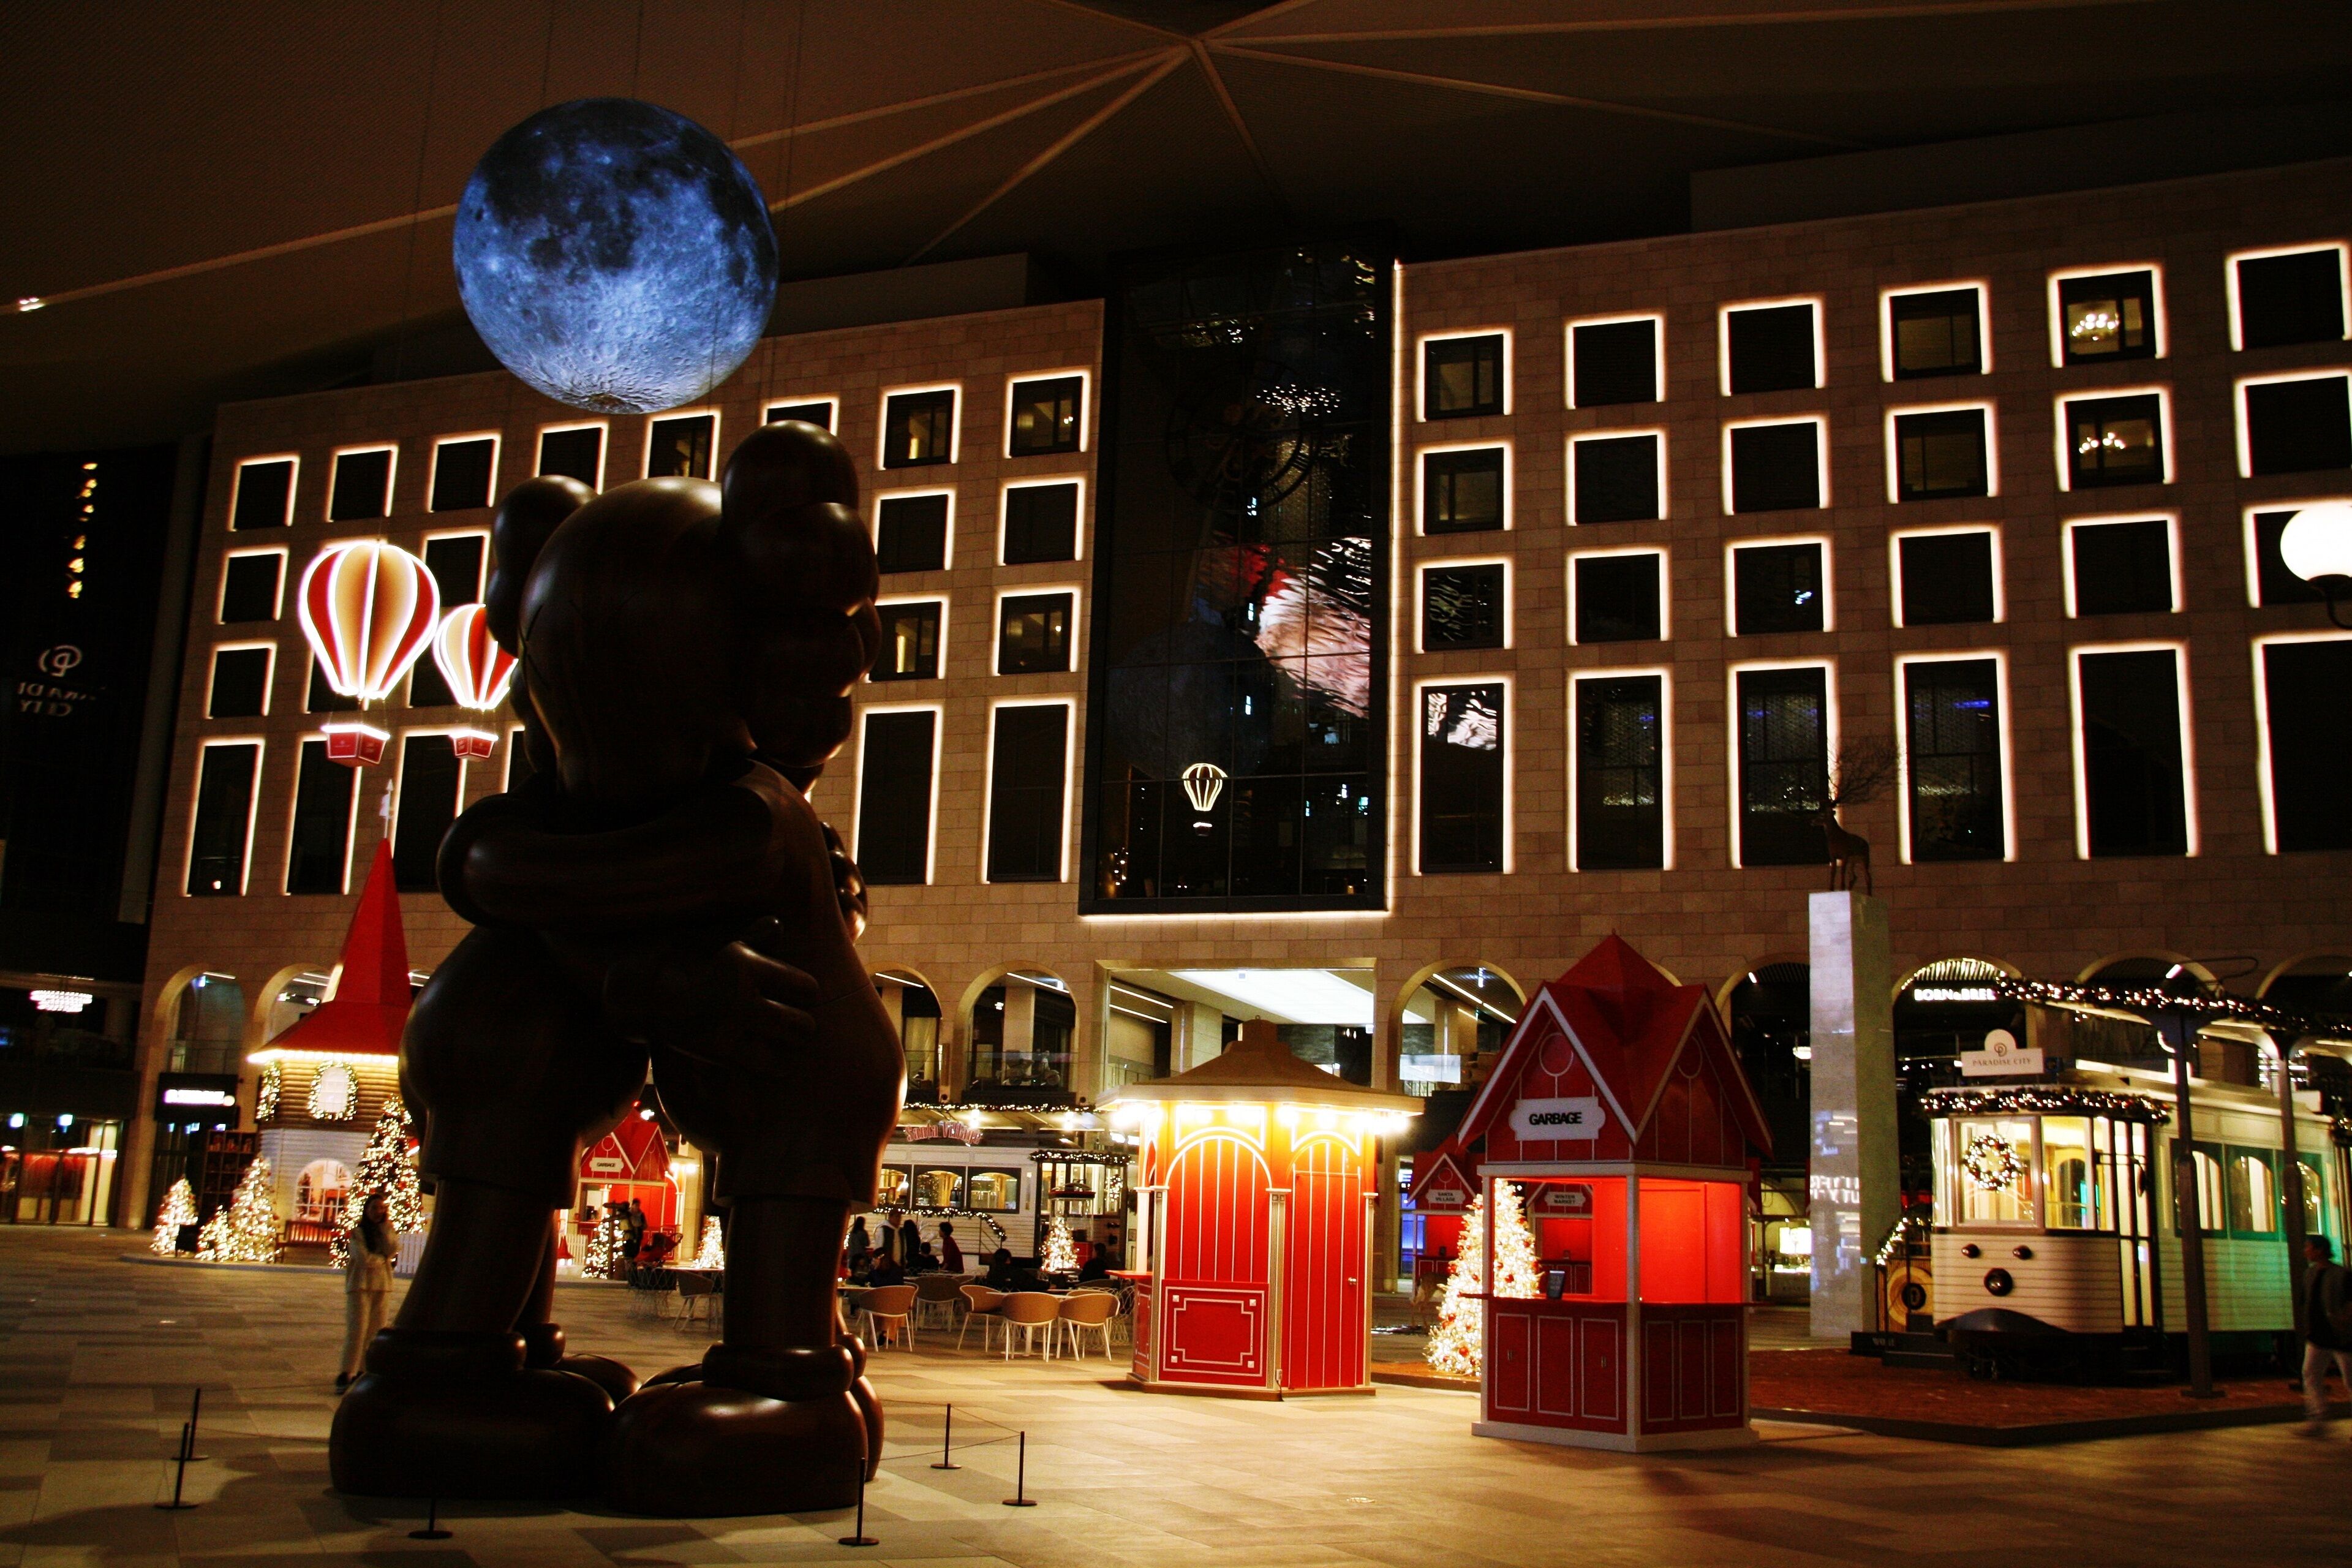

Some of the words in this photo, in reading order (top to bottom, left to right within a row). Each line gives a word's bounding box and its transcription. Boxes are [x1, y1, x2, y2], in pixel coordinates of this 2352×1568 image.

[1972, 1058, 2011, 1066] PARADISE
[1529, 1112, 1582, 1125] GARBAGE
[907, 1120, 938, 1142] Santa
